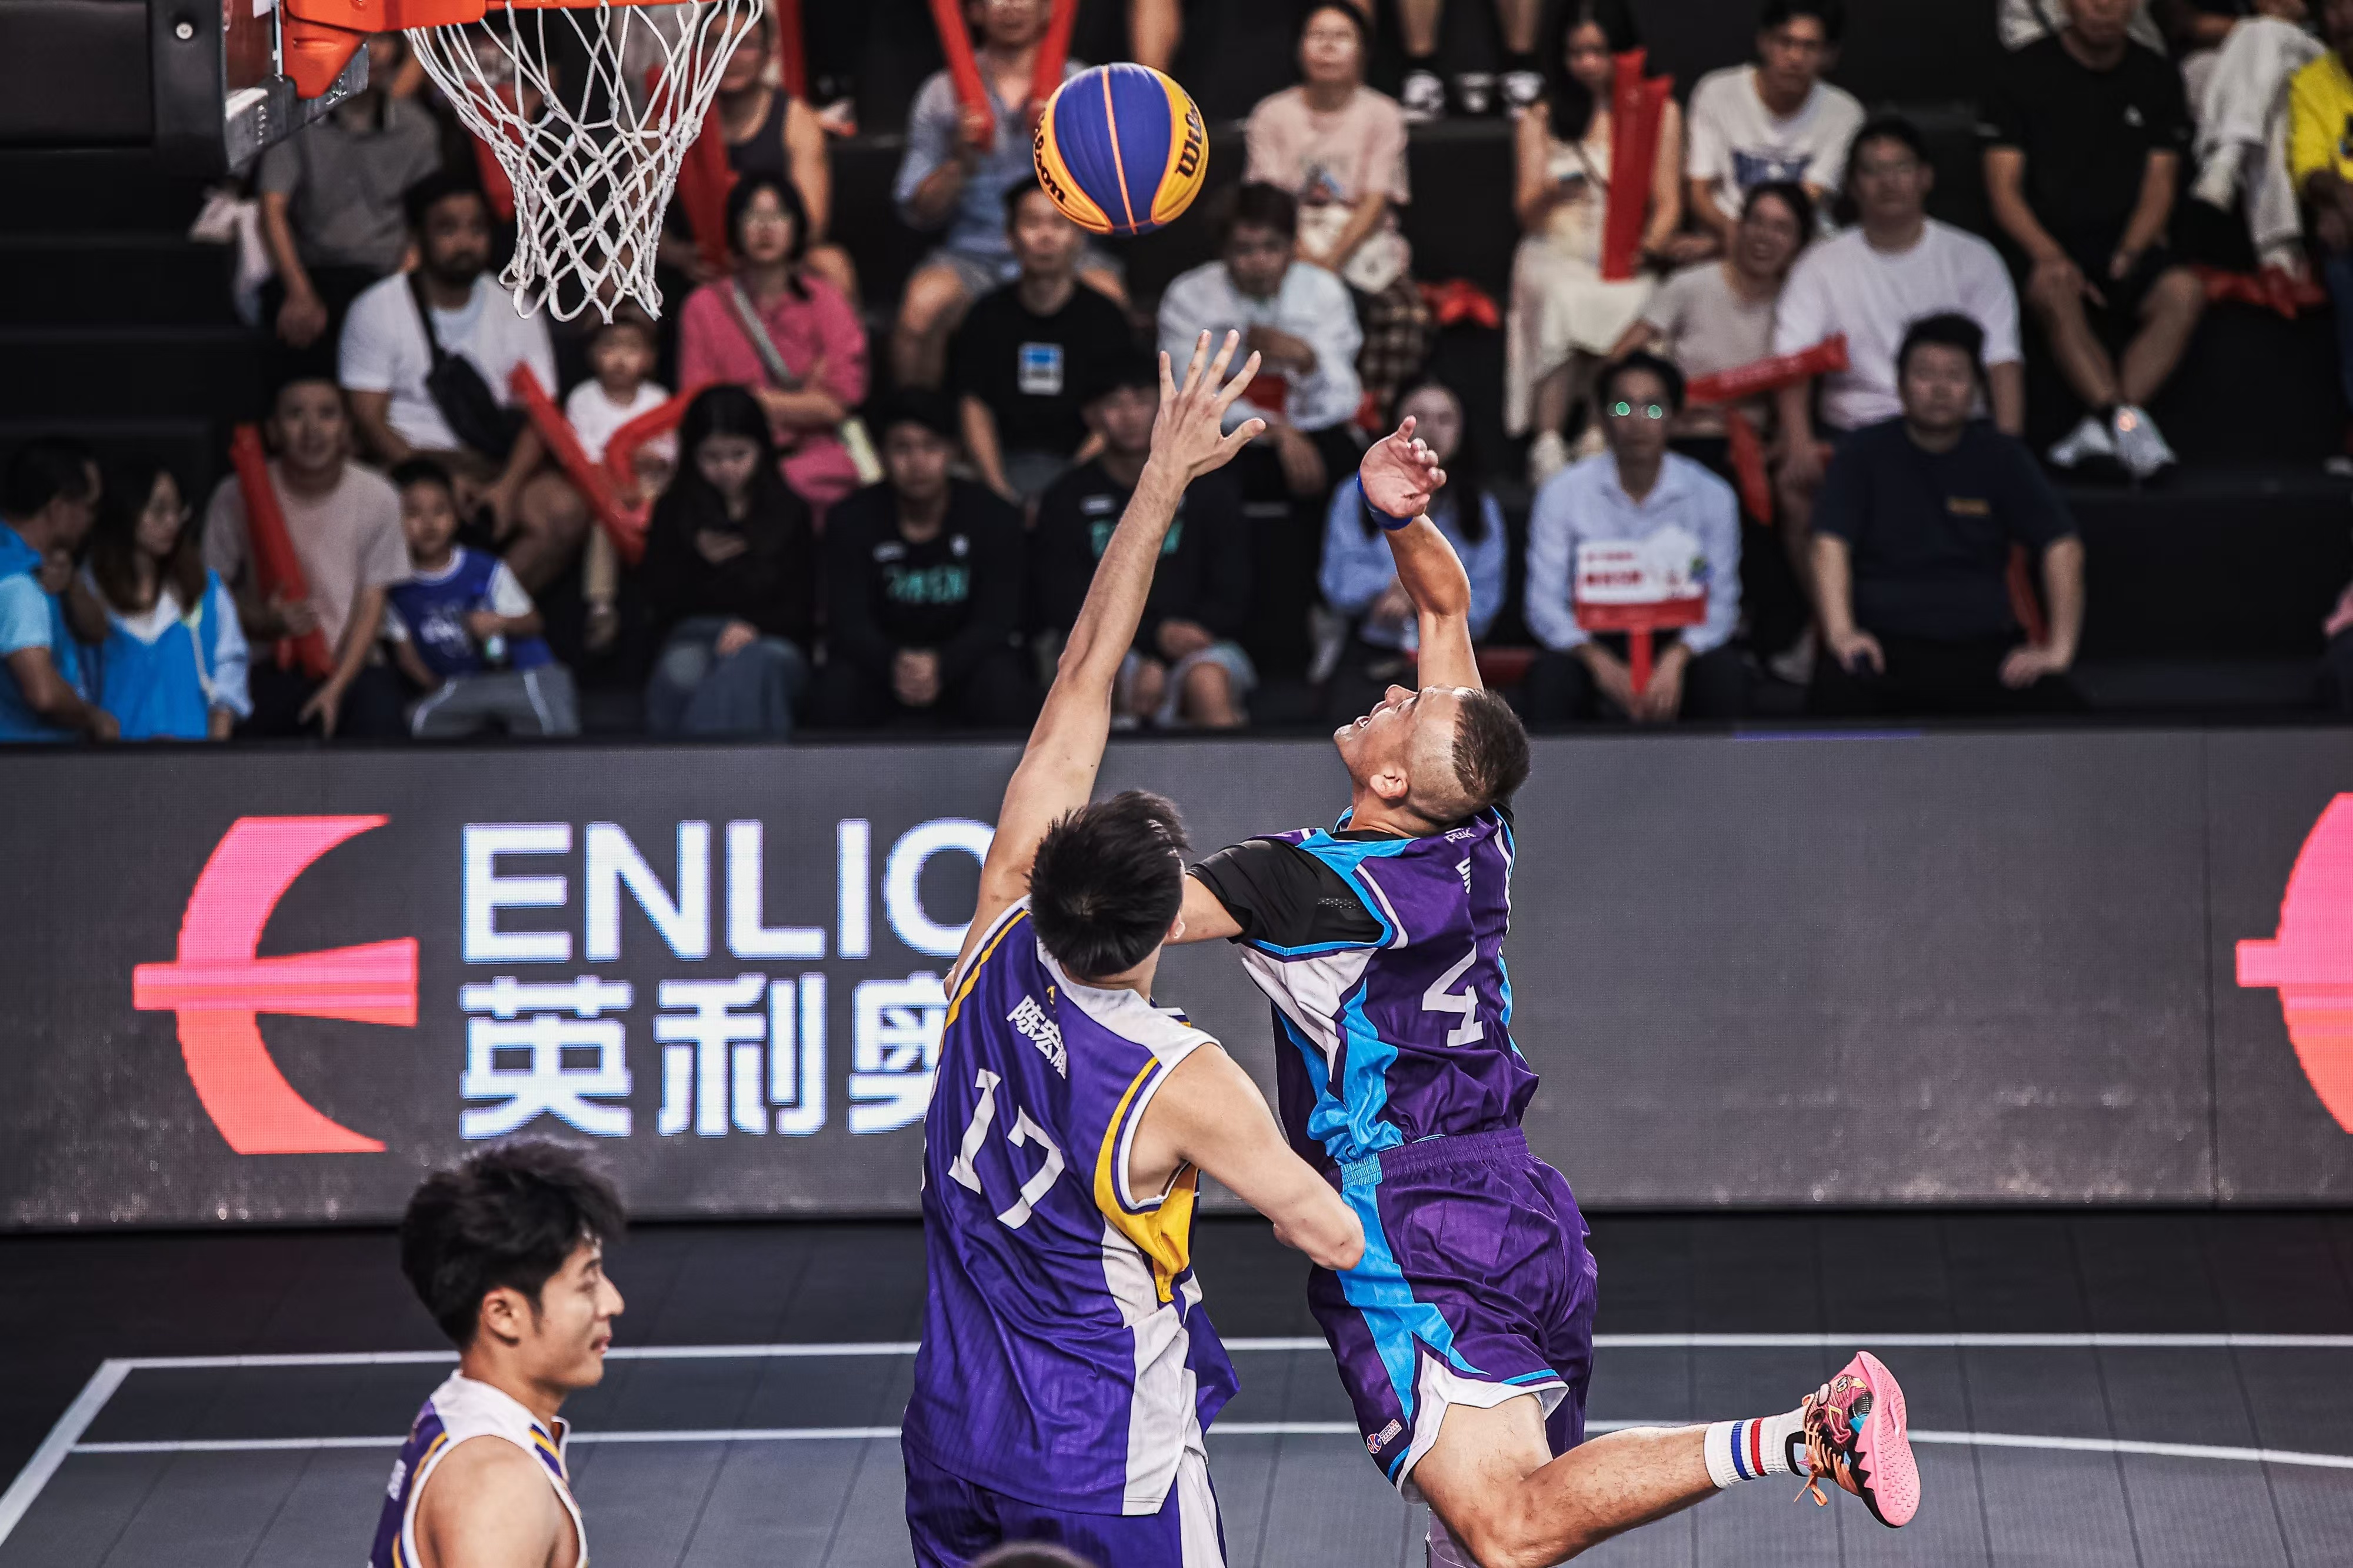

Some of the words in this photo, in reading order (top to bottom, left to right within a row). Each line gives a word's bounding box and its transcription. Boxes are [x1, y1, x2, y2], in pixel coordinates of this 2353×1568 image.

[461, 817, 995, 963] ENLIO
[1421, 942, 1484, 1047] 4
[948, 1068, 1065, 1230] 17
